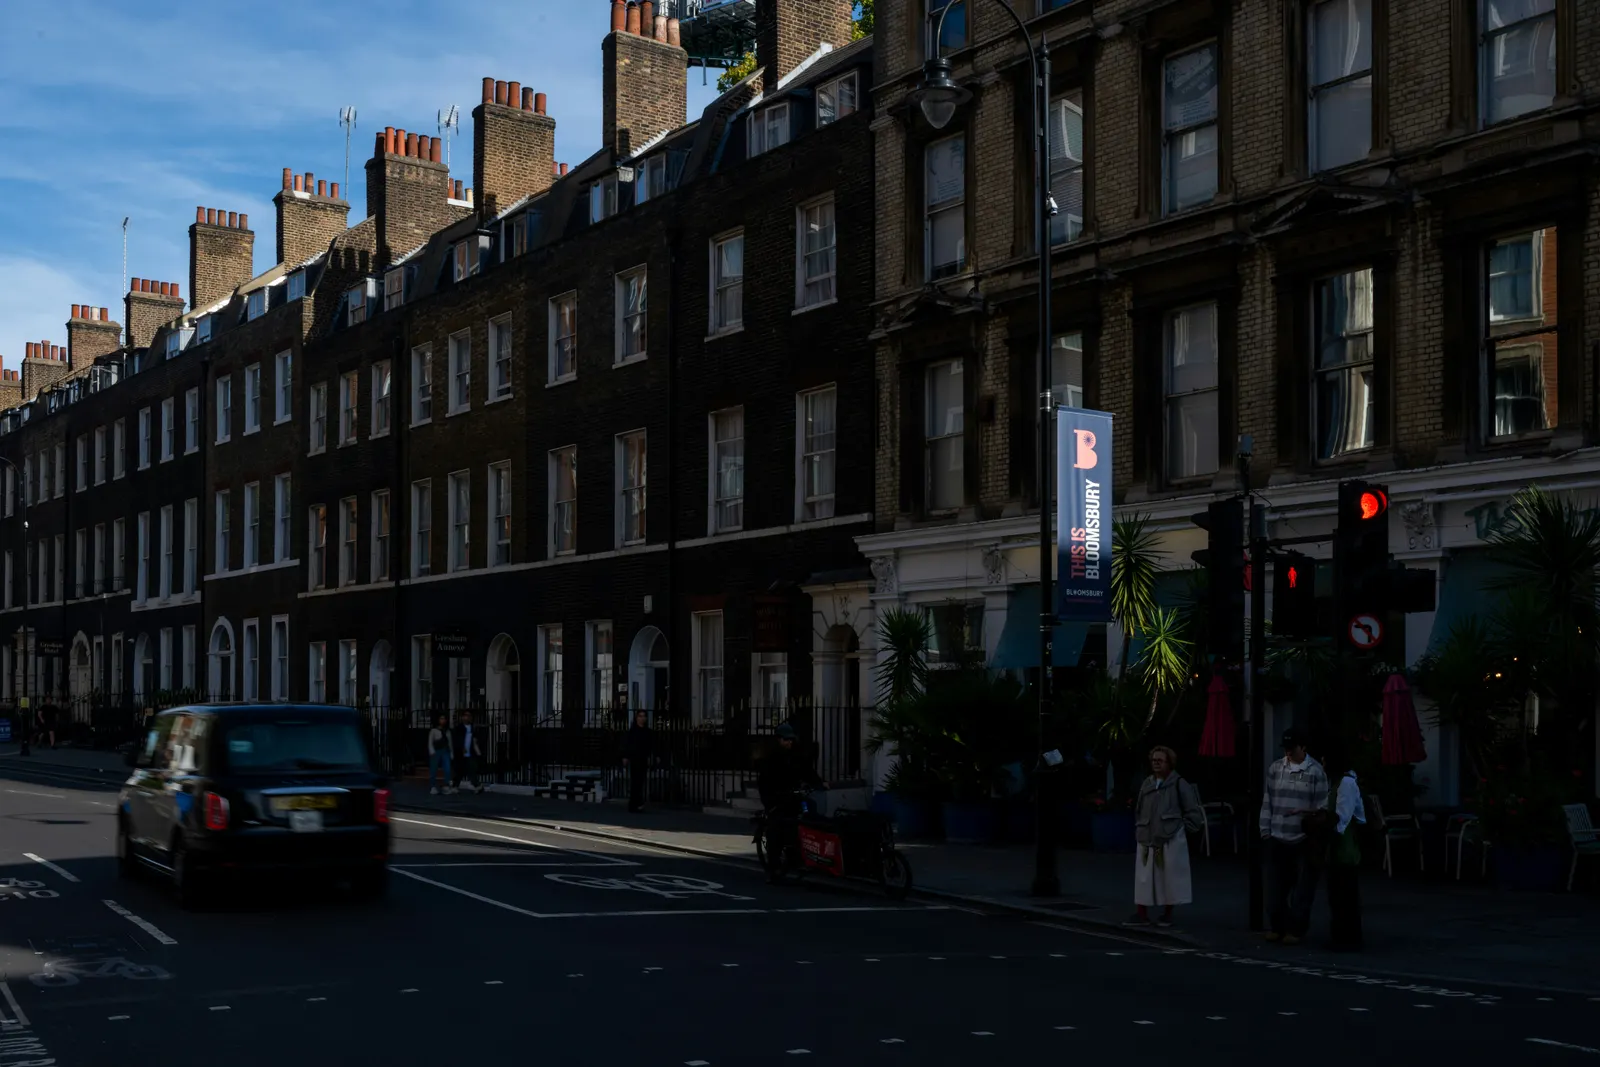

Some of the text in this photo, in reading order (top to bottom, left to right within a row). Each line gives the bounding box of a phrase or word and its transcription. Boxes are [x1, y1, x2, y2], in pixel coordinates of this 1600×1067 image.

[1073, 429, 1098, 470] B
[1072, 527, 1085, 579] THIS IS
[1086, 479, 1100, 580] BLOOMSBURY
